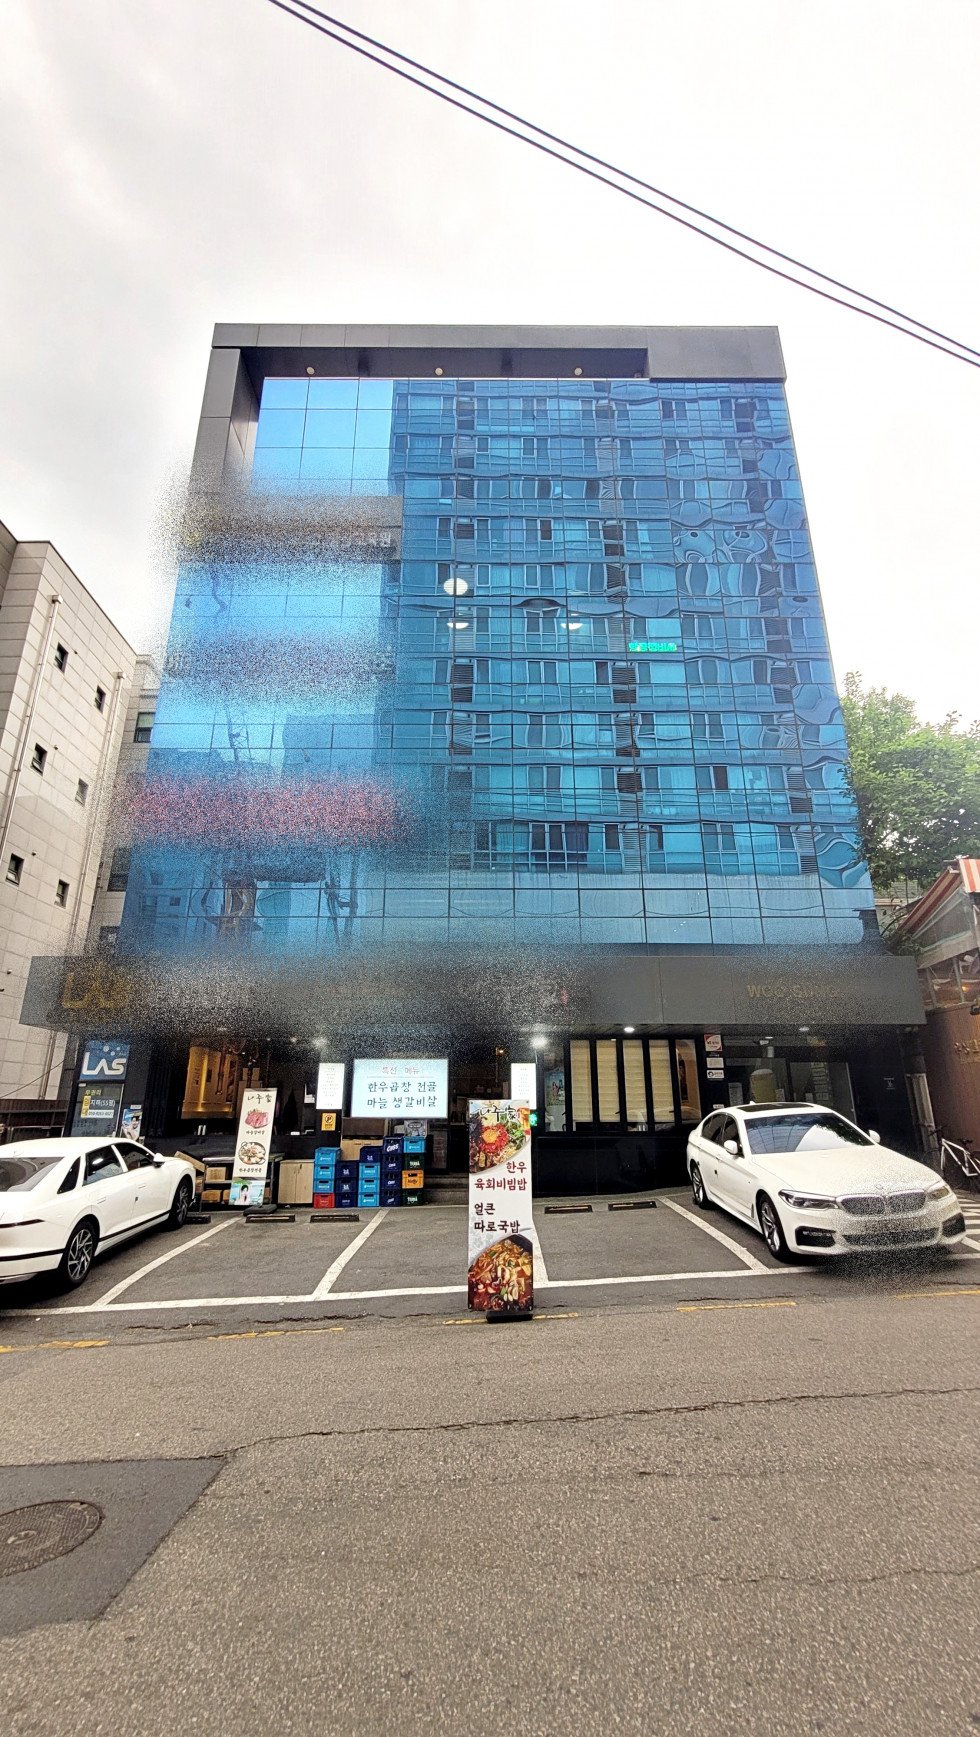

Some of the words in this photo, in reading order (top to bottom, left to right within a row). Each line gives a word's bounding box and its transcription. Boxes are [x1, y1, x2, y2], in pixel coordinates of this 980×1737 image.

[82, 1051, 127, 1075] LAS
[404, 1066, 420, 1075] 메뉴
[368, 1081, 411, 1092] 한우곱창
[417, 1081, 437, 1092] 전골
[367, 1097, 388, 1109] 마늘
[392, 1096, 437, 1108] 생갈비살
[506, 1161, 527, 1174] 한우
[474, 1178, 527, 1191] 육회비빔밥
[474, 1202, 496, 1215] 얼큰
[474, 1220, 520, 1233] 따로국밥
